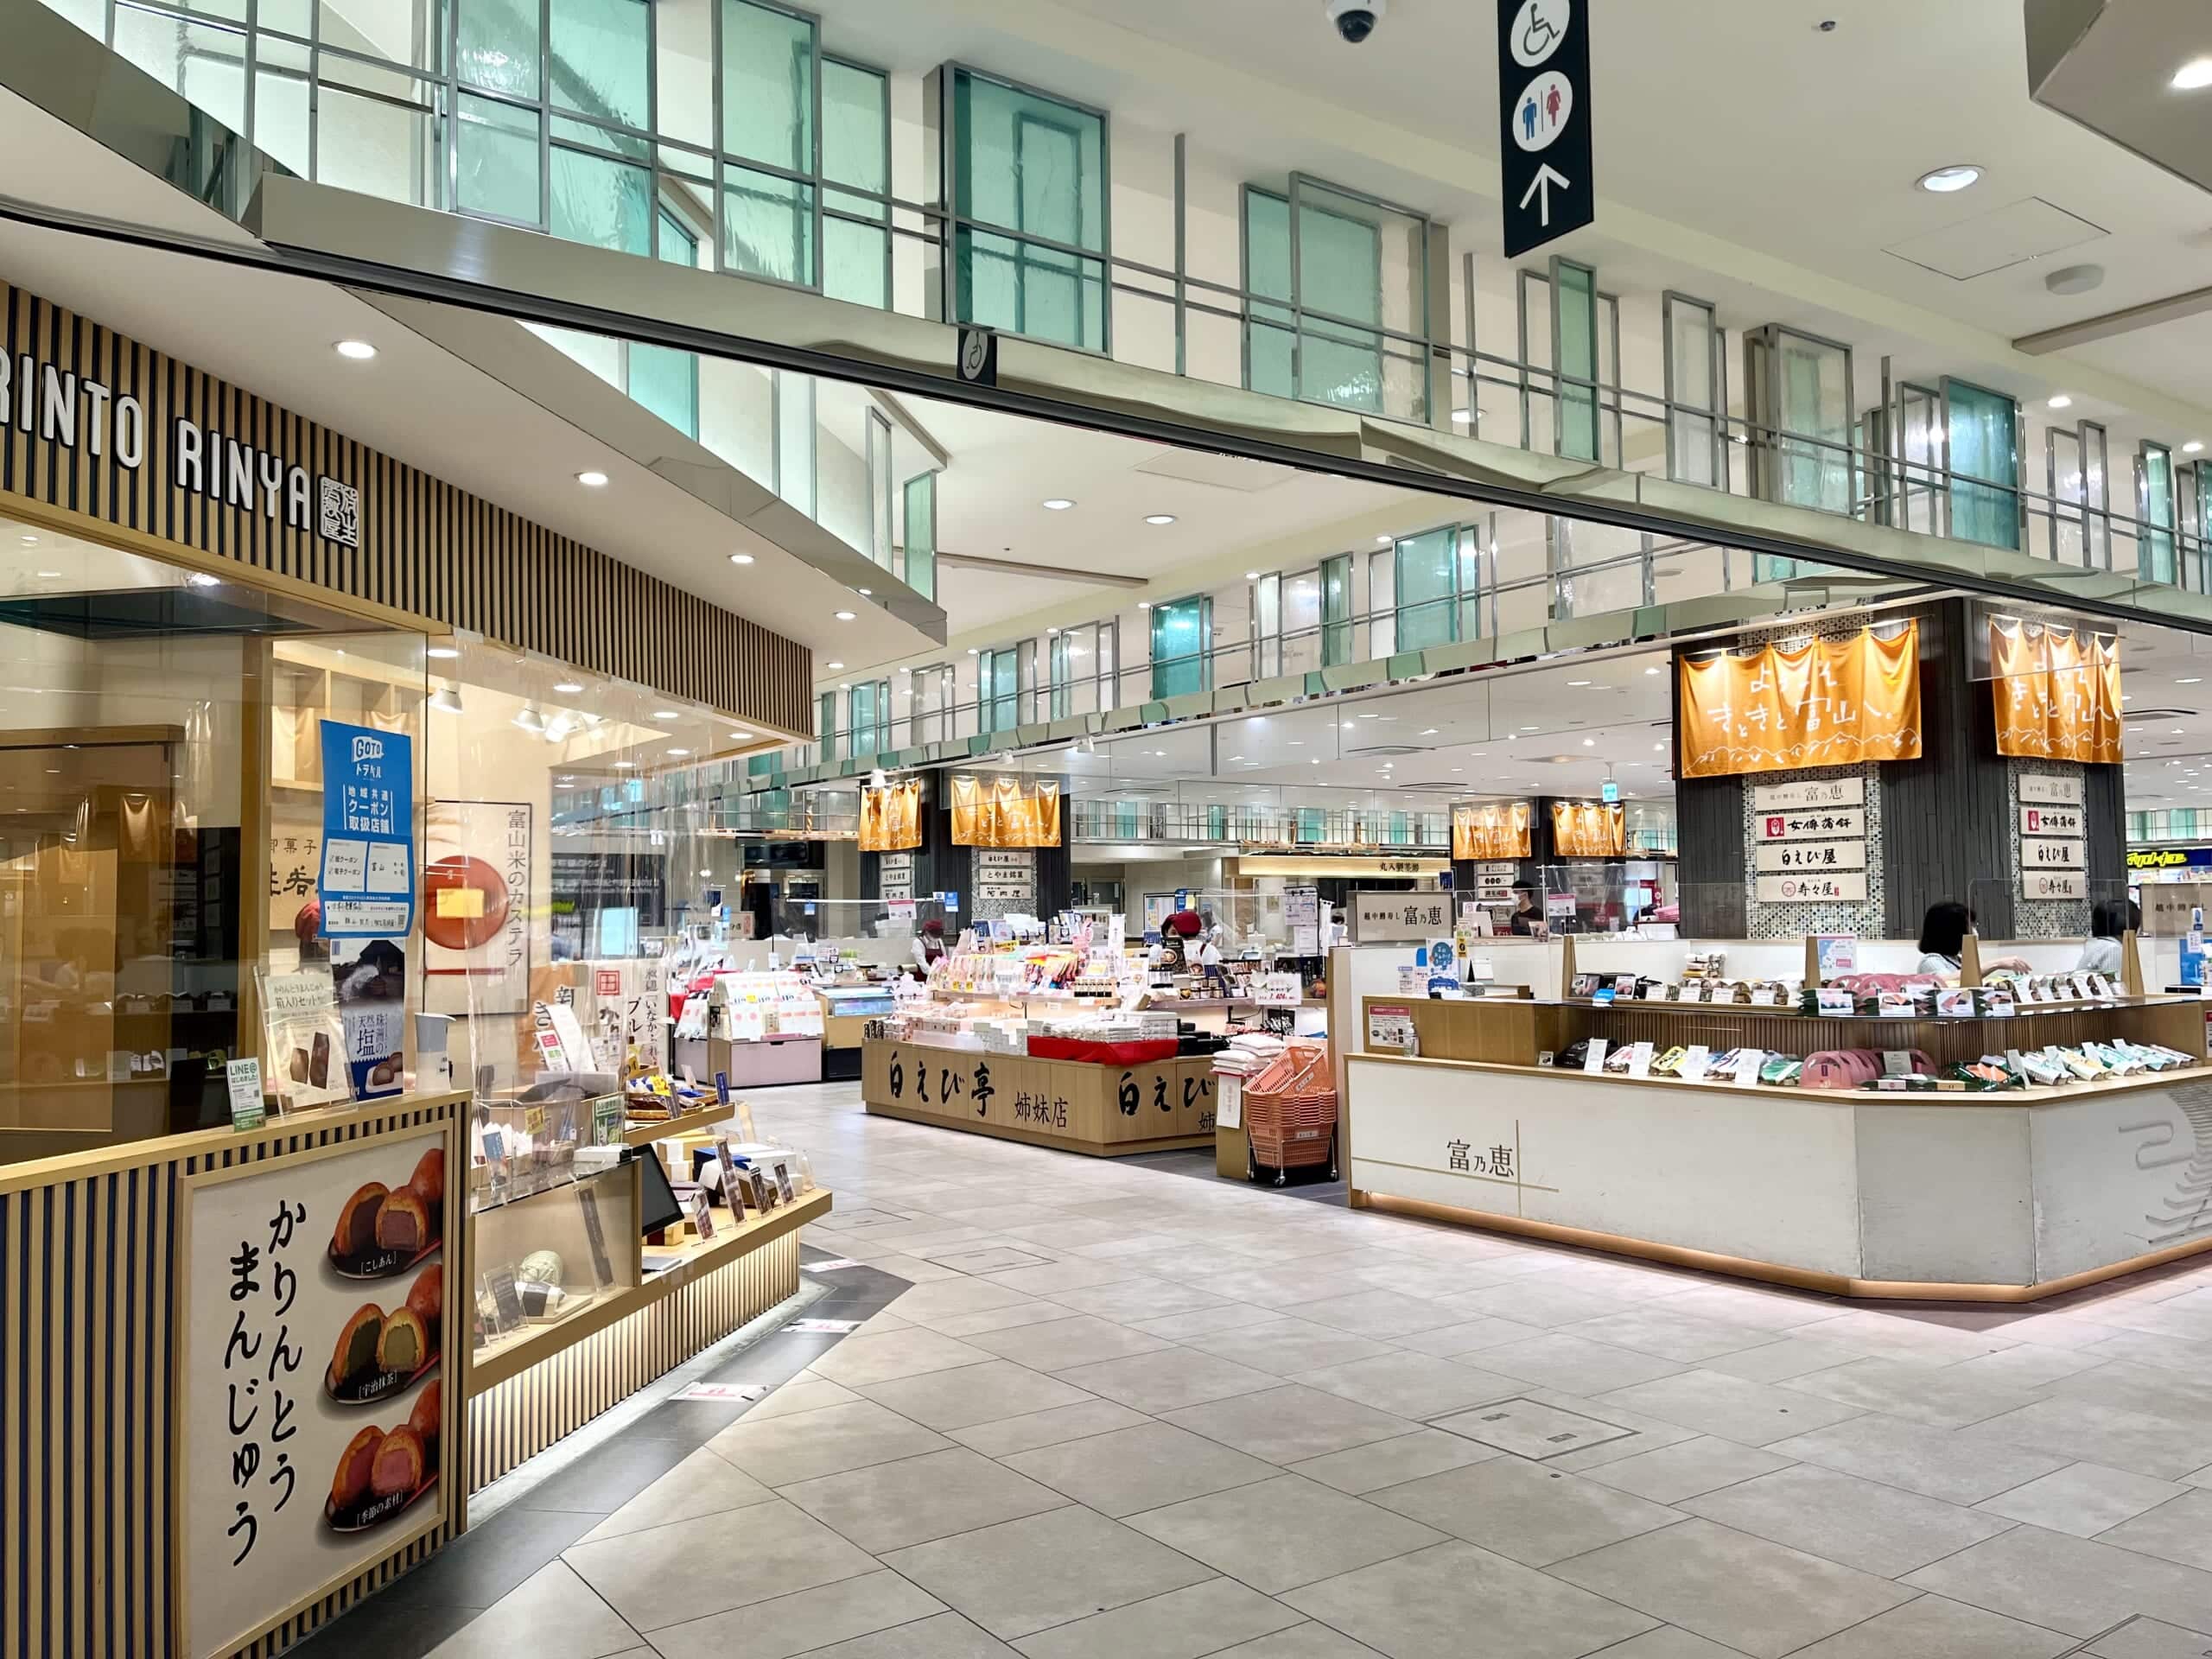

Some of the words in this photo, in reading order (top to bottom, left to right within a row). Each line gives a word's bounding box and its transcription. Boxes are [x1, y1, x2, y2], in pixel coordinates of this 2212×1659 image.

[176, 418, 311, 531] RINYA
[356, 764, 382, 779] トラベル
[348, 799, 388, 817] クーポン
[348, 816, 390, 834] 取扱店舗
[1782, 849, 1837, 866] 白えび屋
[2037, 844, 2070, 862] 白えび屋
[506, 810, 525, 967] 富山米のカステラ
[1403, 906, 1442, 926] 富乃恵
[889, 1050, 995, 1117] 白えび亭
[1014, 1091, 1069, 1128] 姉妹店
[1118, 1071, 1216, 1116] 白えび
[1446, 1139, 1515, 1178] 富乃恵
[266, 1198, 307, 1514] かりんとう
[224, 1240, 263, 1567] まんじゅう
